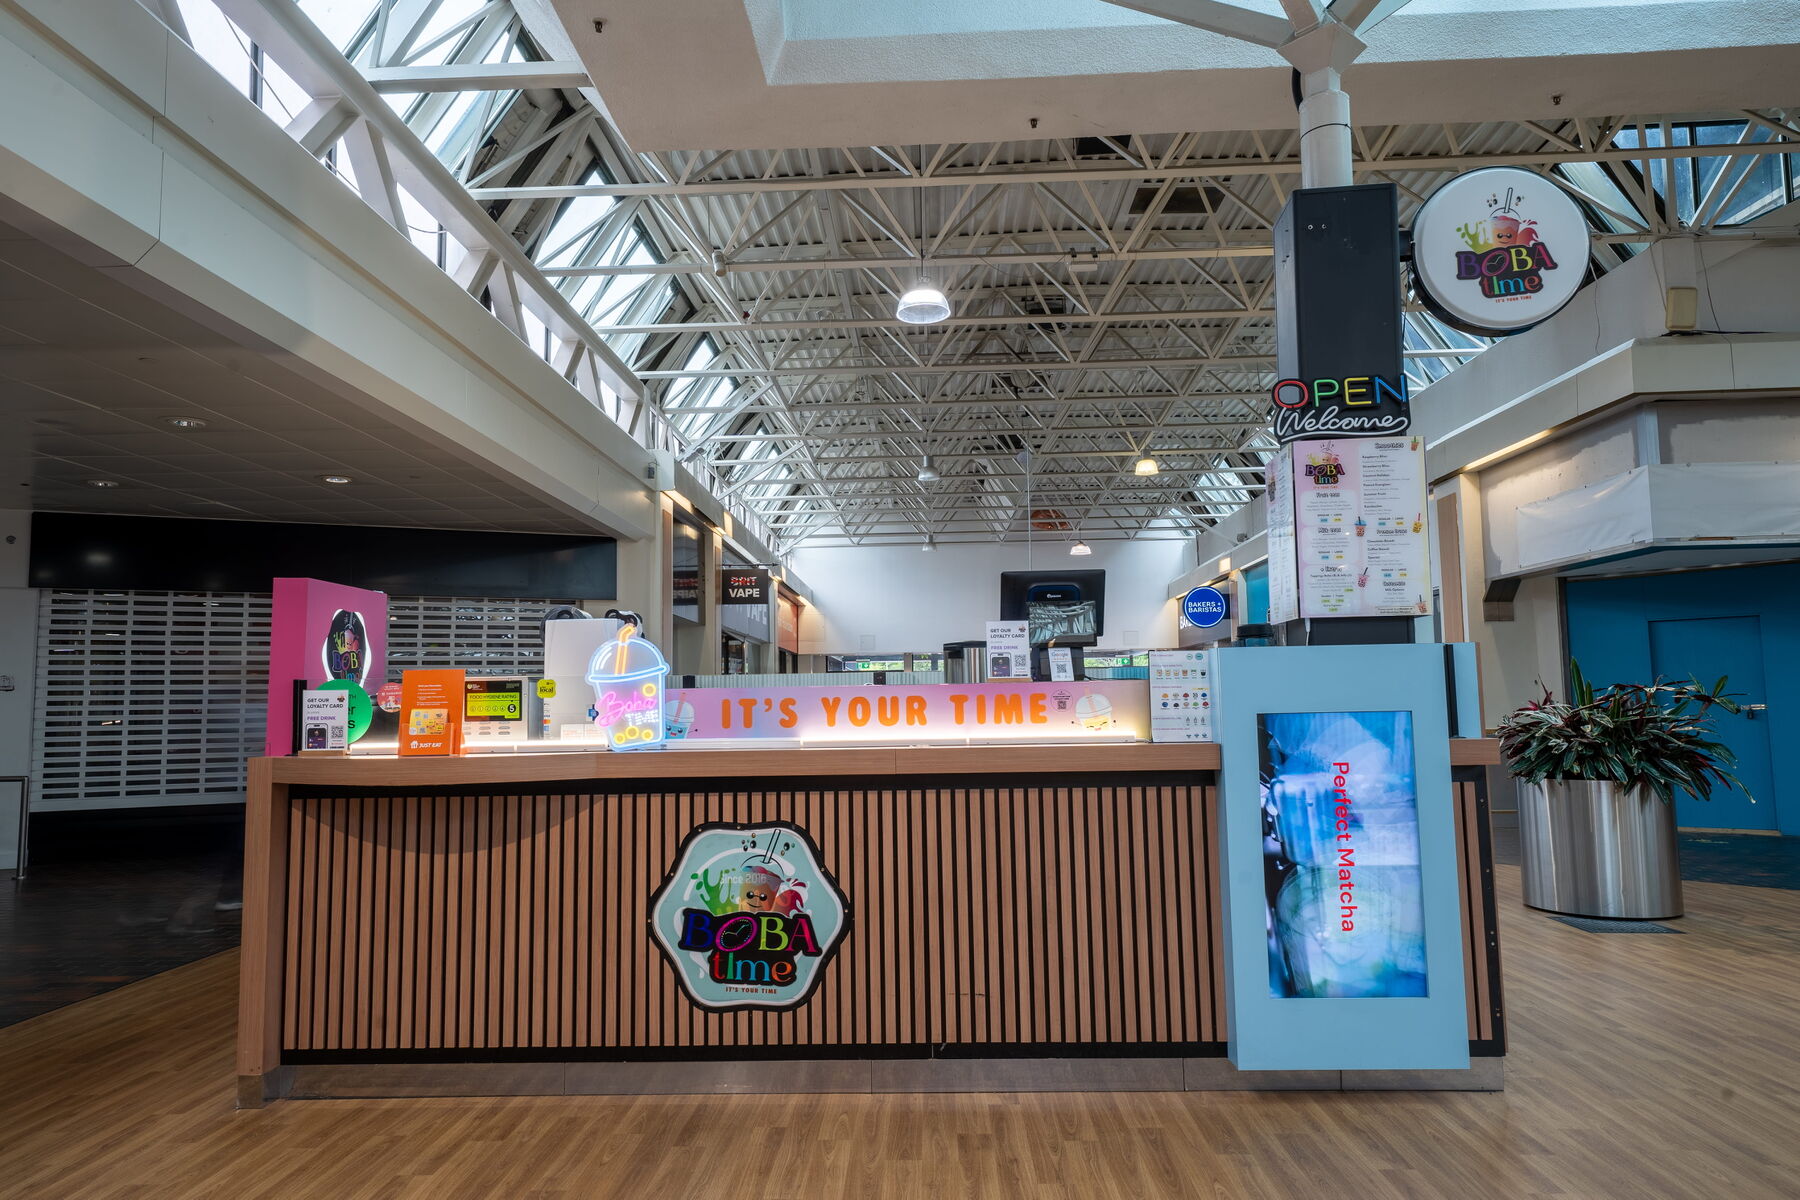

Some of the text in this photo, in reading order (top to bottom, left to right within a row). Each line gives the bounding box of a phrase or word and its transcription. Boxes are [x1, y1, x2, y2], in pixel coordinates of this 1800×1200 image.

[1458, 245, 1554, 279] BOBA
[1482, 275, 1540, 296] time
[1274, 375, 1407, 408] OPEN
[1277, 405, 1409, 439] Welcome
[1306, 464, 1345, 476] BOBA
[1314, 475, 1339, 485] time
[729, 588, 760, 598] VAPE
[730, 576, 758, 586] BRIT
[539, 686, 554, 694] local
[595, 690, 657, 727] Boba
[721, 693, 1048, 729] IT'S YOUR TIME
[1333, 762, 1358, 932] Perfect Matcha
[684, 912, 817, 953] BOBA
[713, 952, 793, 982] time
[741, 986, 759, 994] YOUR
[761, 987, 778, 995] TIME
